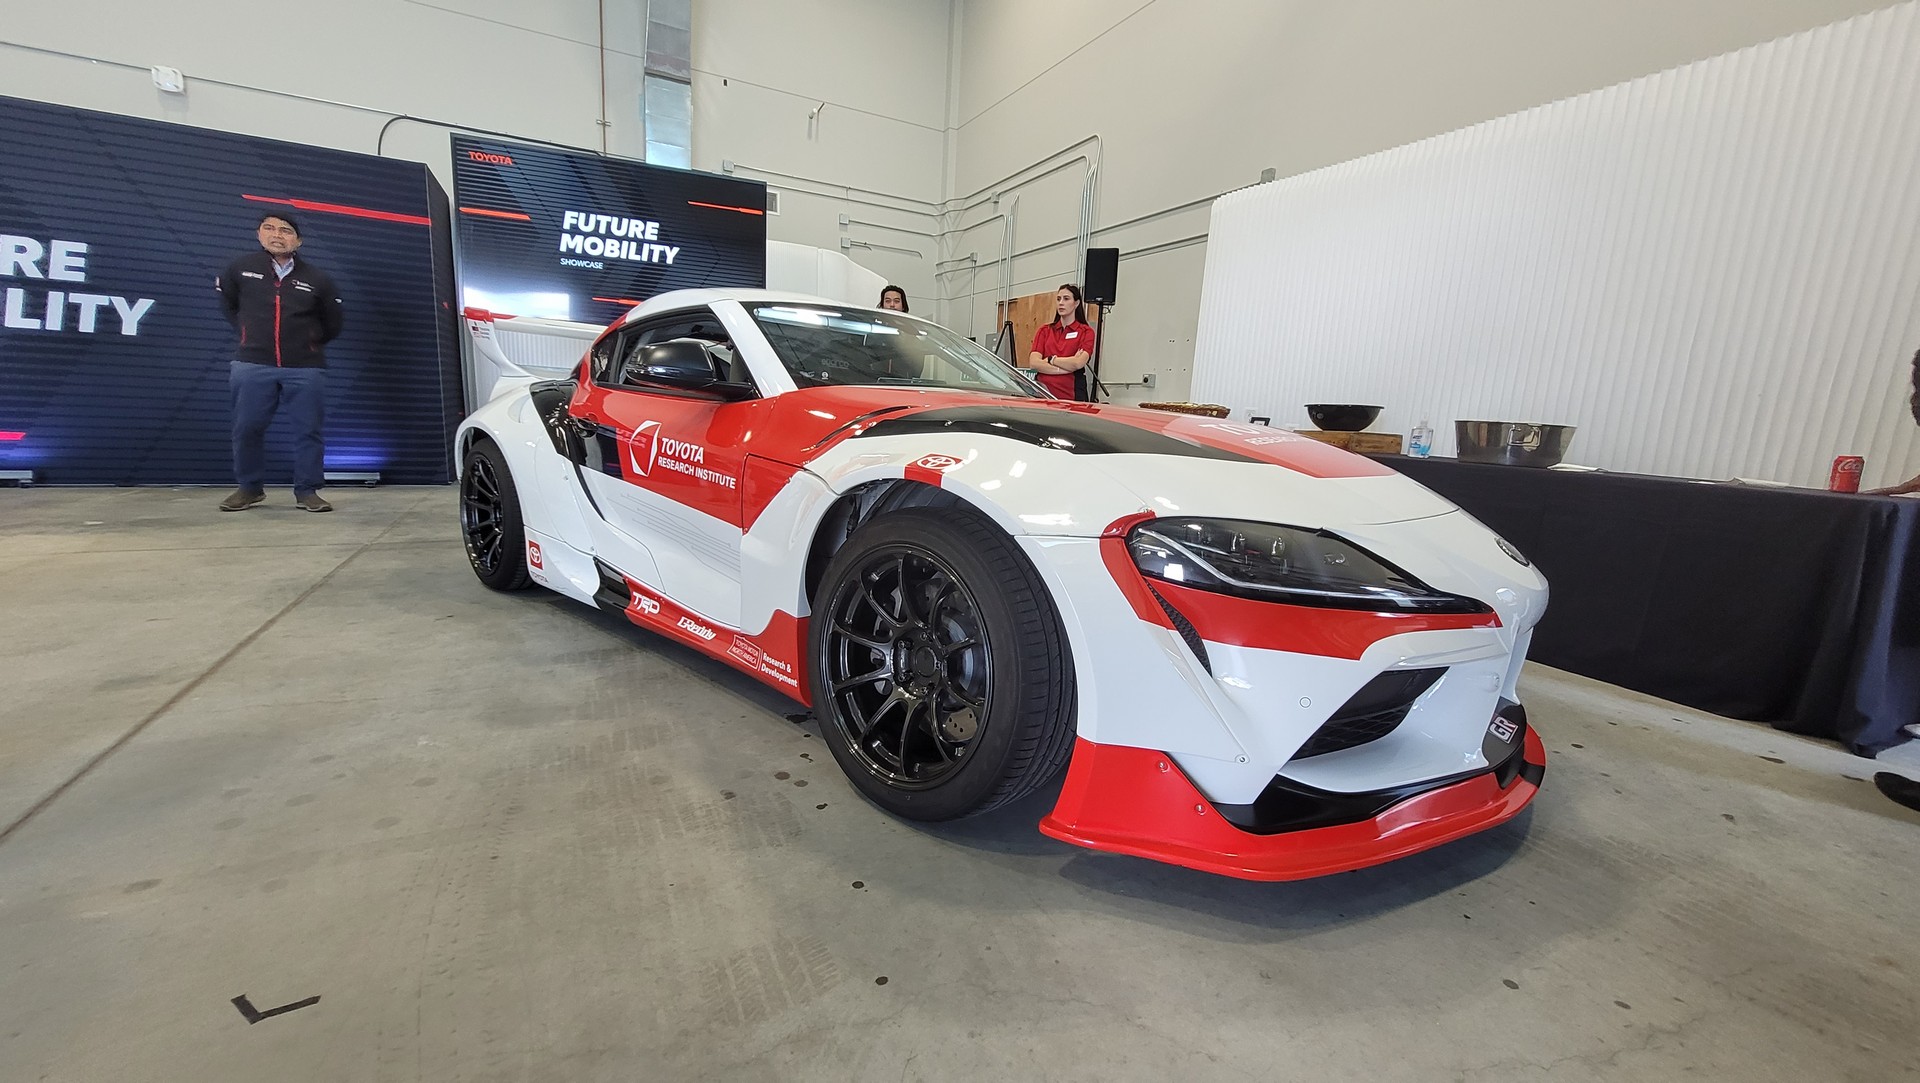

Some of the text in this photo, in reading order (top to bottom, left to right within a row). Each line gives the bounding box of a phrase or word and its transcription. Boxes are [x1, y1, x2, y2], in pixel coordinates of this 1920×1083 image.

[468, 151, 513, 165] TOYOTA
[562, 210, 660, 241] FUTURE
[559, 233, 680, 265] MOBILITY
[560, 258, 603, 270] SHOWCASE
[661, 437, 705, 464] TOYOTA
[657, 456, 737, 489] RESEARCH INSTITUTE
[633, 591, 660, 614] TRD
[676, 616, 717, 641] GReddy
[760, 663, 798, 687] Development
[762, 652, 792, 673] Research &
[1489, 716, 1517, 741] GR
